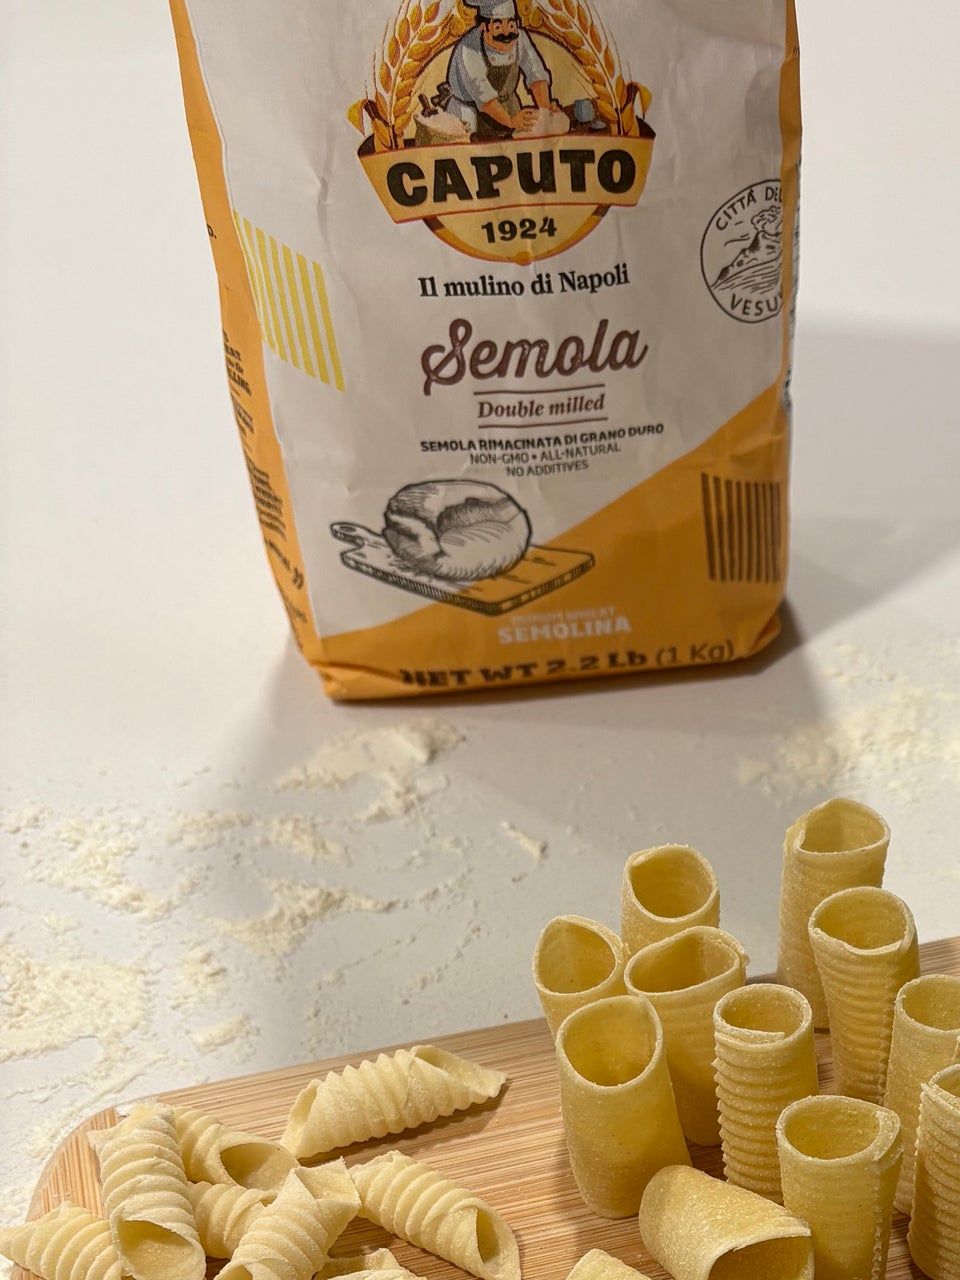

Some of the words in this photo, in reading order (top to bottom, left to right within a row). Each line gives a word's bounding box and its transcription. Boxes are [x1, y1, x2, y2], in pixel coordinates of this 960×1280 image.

[386, 149, 636, 207] CAPUTO
[715, 188, 758, 231] CITTÀ
[481, 216, 558, 243] 1924
[417, 276, 439, 298] Il
[443, 275, 525, 297] mulino
[530, 273, 554, 295] di
[558, 263, 631, 294] Napoli
[730, 293, 783, 317] VESU
[421, 318, 649, 396] Semola
[477, 400, 545, 418] Double
[548, 393, 606, 416] milled
[420, 440, 476, 452] SEMOLA
[478, 435, 562, 451] RIMACINATA
[564, 433, 578, 445] DI
[580, 428, 626, 444] GRANO
[628, 423, 665, 437] DURO
[470, 453, 529, 465] NON-GMO
[540, 443, 622, 461] ALL-NATURAL
[506, 466, 525, 477] NO
[527, 460, 589, 476] ADDITIVES
[497, 616, 632, 645] SEMOLINA
[401, 668, 472, 688] NET
[480, 662, 538, 682] WT
[546, 656, 601, 675] 2.2
[608, 650, 648, 667] Lb
[655, 646, 679, 667] (1
[693, 640, 736, 664] Kg)
